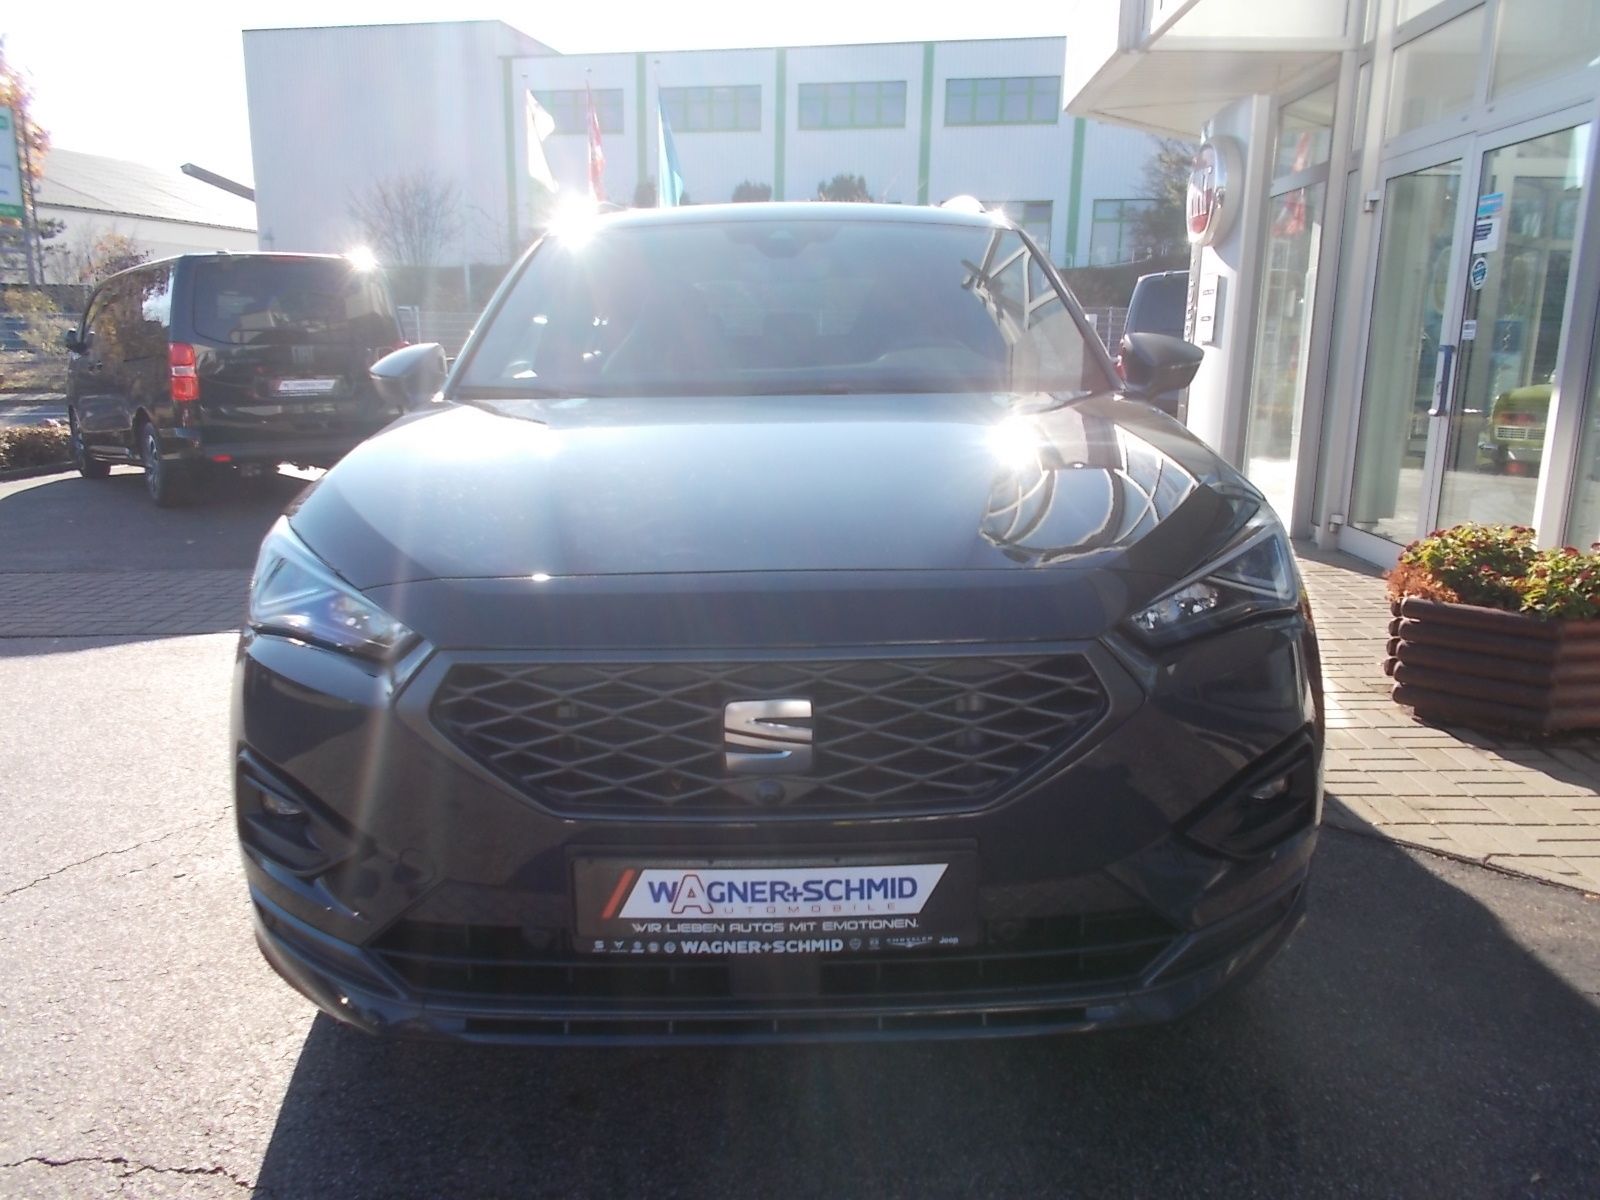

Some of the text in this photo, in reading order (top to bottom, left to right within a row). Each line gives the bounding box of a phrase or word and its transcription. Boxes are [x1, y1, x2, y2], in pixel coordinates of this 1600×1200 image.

[648, 874, 918, 914] WAGNER+SCHMID
[632, 918, 920, 933] WIR LIEBEN AUTOS MIT EMOTIONEN.
[680, 938, 844, 955] WAGNER+SCHMID
